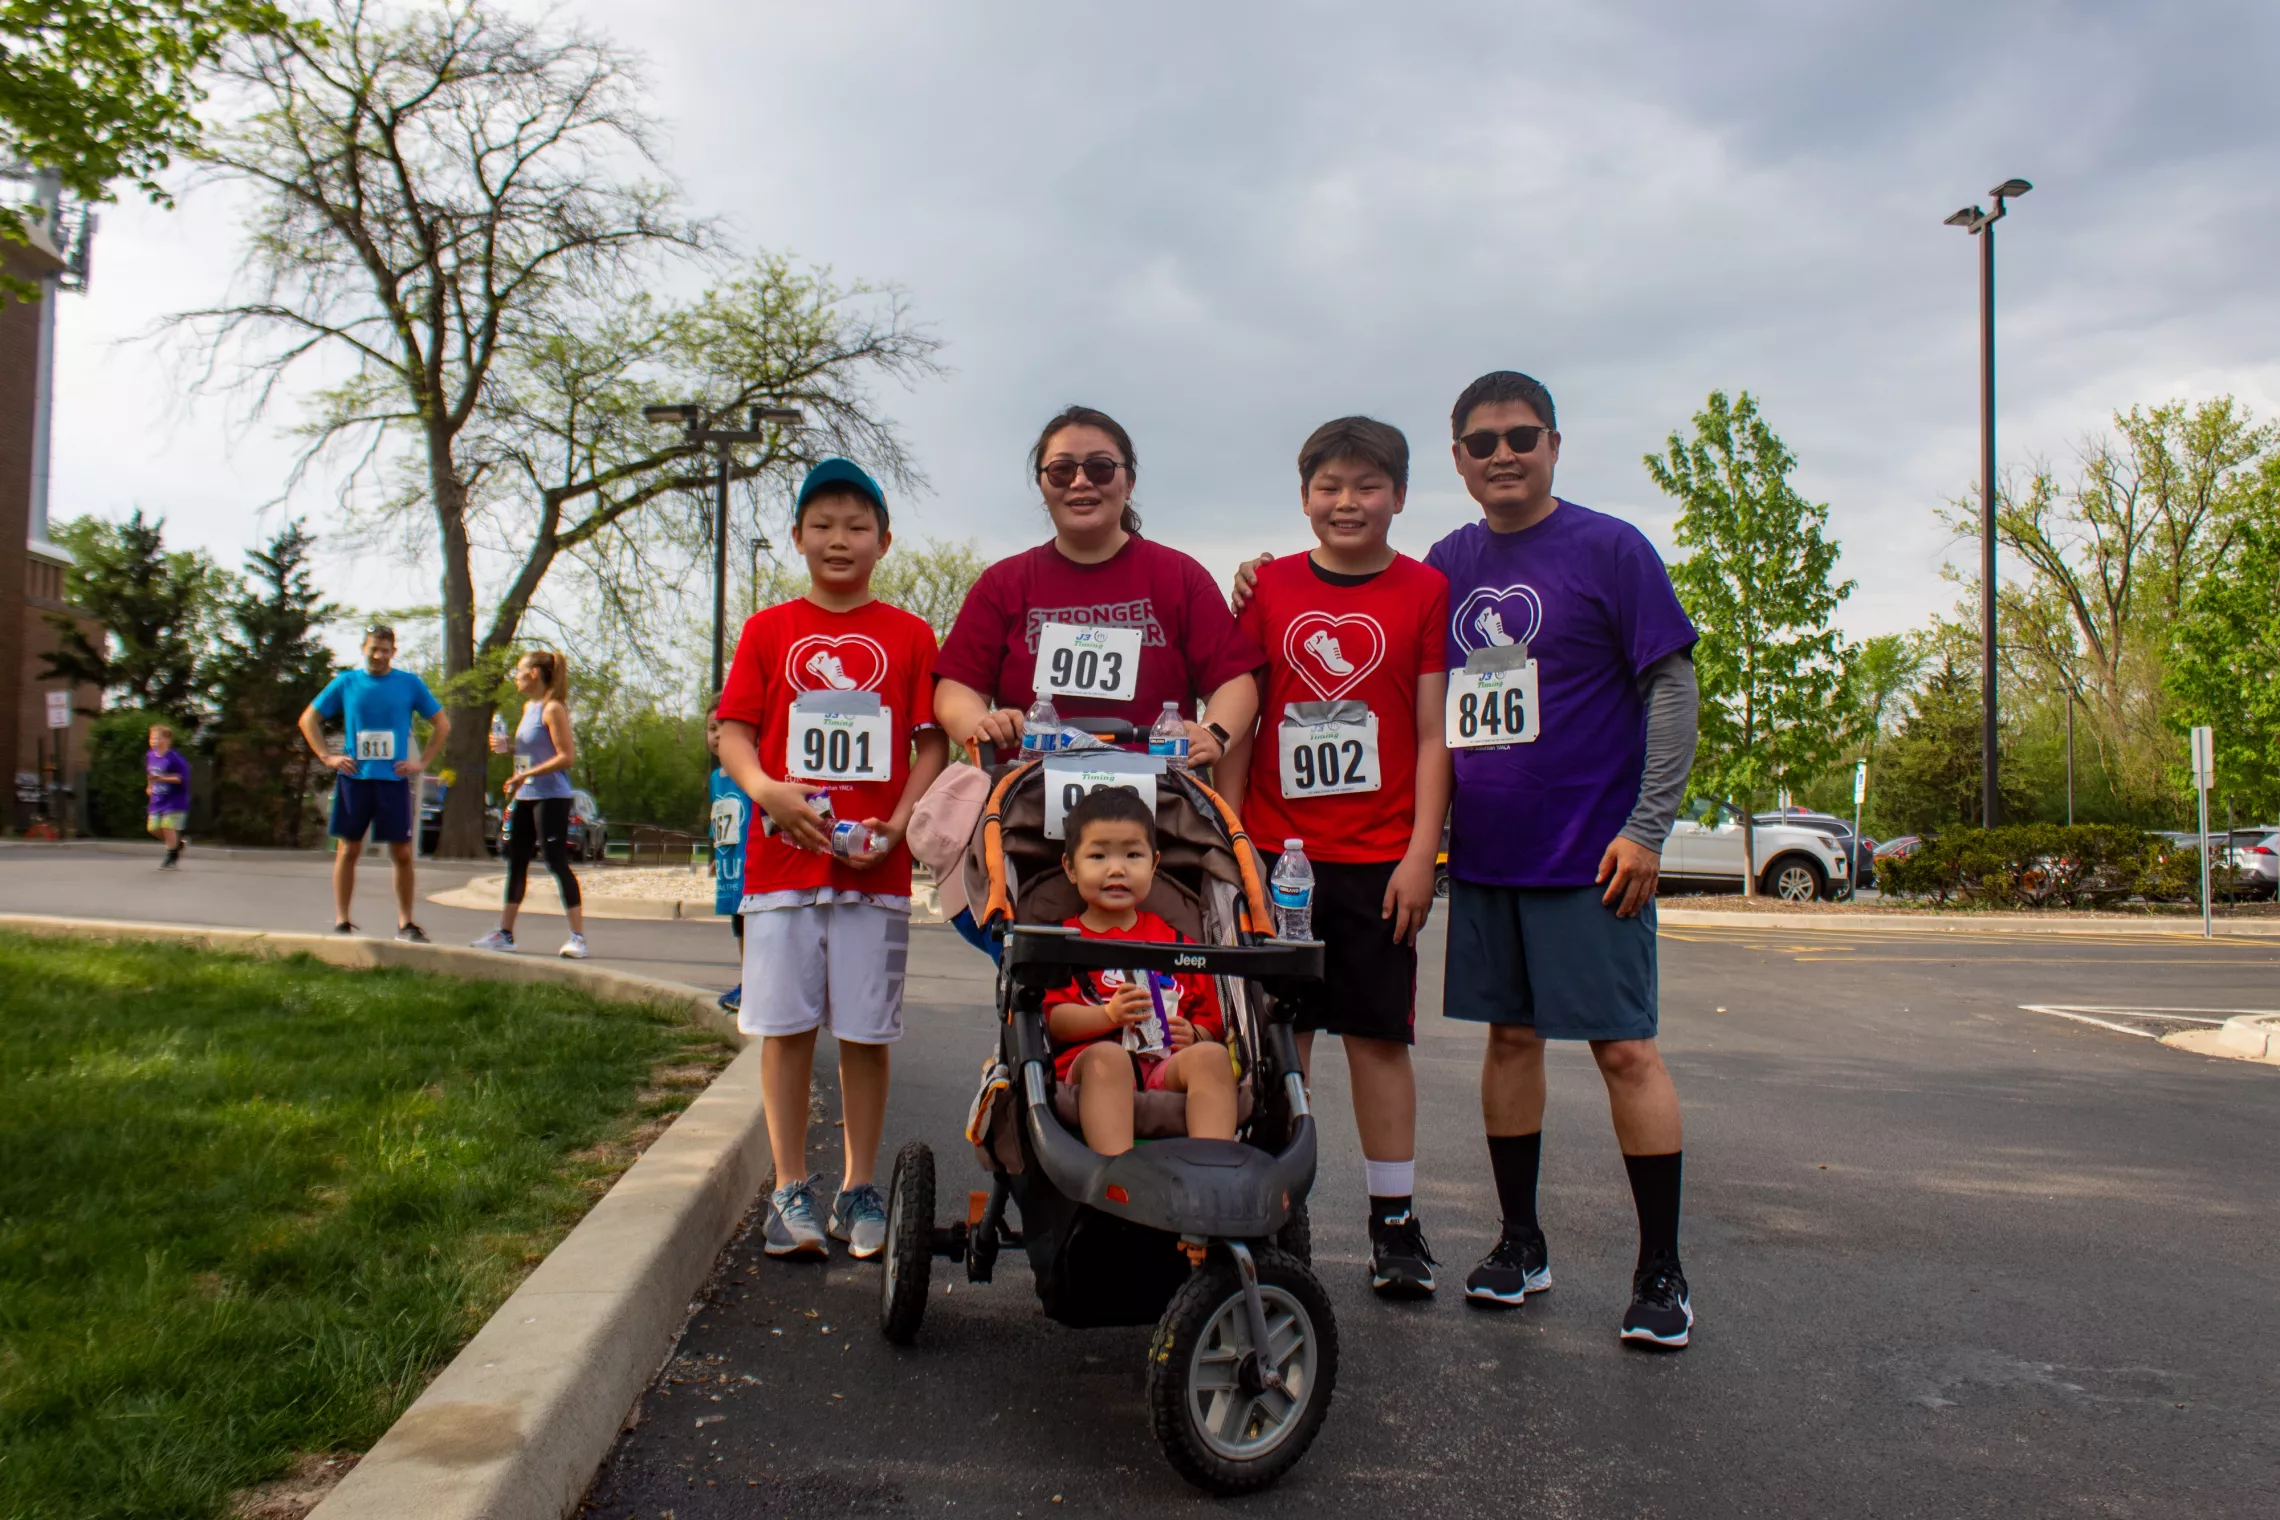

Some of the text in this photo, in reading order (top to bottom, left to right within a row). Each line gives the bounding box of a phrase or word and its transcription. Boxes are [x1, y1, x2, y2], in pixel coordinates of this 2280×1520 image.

[1027, 600, 1155, 631] STRONGER
[1073, 640, 1104, 650] Timing
[1050, 647, 1123, 692] 903
[1477, 681, 1504, 689] Timing
[1459, 688, 1525, 738] 846
[823, 718, 854, 728] Timing
[362, 741, 389, 757] 811
[803, 728, 874, 773] 901
[1293, 740, 1367, 789] 902
[1082, 773, 1116, 782] Timing
[1174, 953, 1206, 968] Jeep
